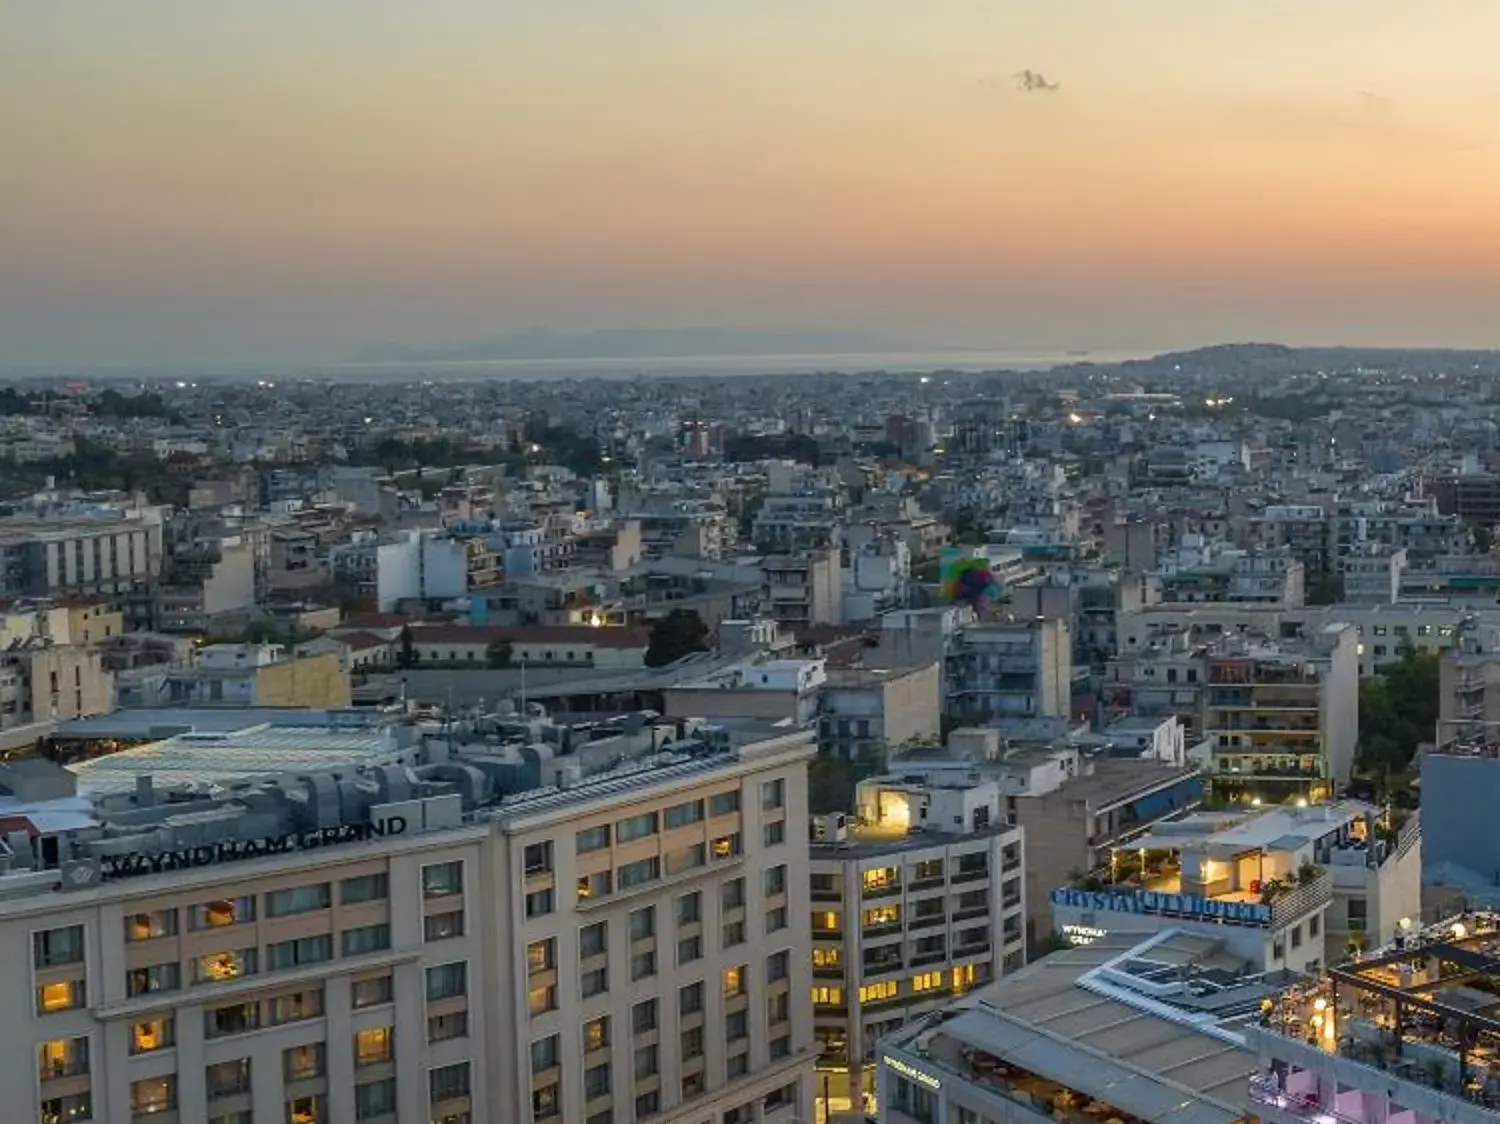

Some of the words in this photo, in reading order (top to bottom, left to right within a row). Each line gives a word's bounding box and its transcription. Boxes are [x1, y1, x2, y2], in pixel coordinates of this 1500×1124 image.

[109, 834, 294, 877] WYNDHAM
[303, 815, 407, 848] GRAND
[1051, 888, 1145, 914] CRYSTAL
